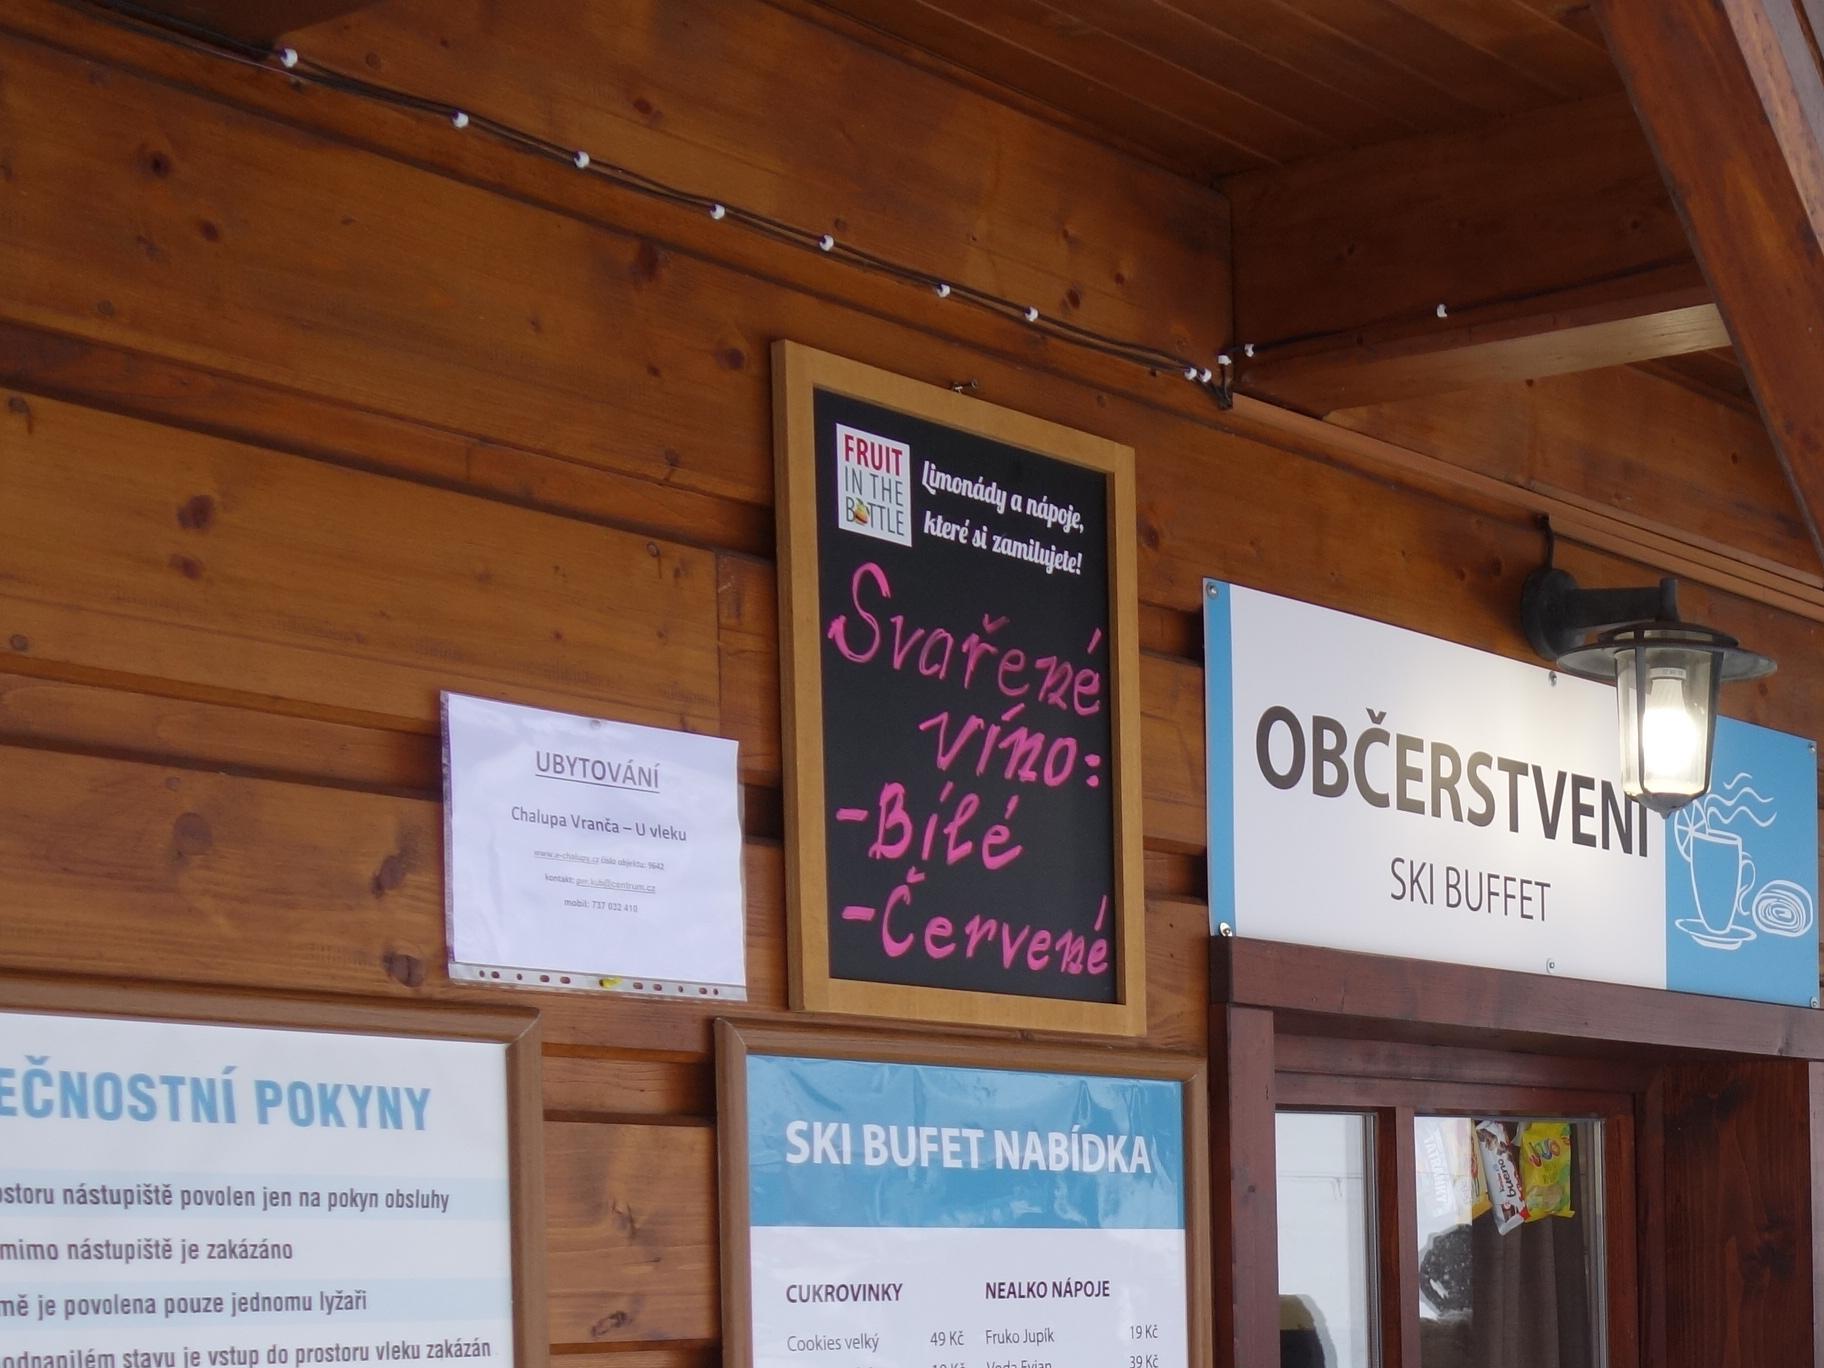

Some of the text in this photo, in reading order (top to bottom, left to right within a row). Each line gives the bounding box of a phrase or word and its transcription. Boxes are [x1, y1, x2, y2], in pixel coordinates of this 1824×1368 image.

[844, 434, 903, 476] FRUIT
[845, 466, 904, 507] IN THE
[922, 461, 1084, 534] Limonády a nápoje,
[924, 511, 1082, 575] které si zamilujete!
[827, 562, 1102, 717] Svařené
[919, 702, 1102, 789] víno:
[536, 750, 660, 790] UBYTOVÁNÍ
[511, 806, 567, 828] Chalupa
[571, 814, 620, 834] Vranča
[635, 822, 646, 836] U
[650, 825, 687, 842] vleku
[1390, 856, 1551, 923] SKI BUFFET
[256, 1080, 432, 1131] POKYNY
[785, 1120, 1152, 1174] SKI BUFET NABÍDKA
[63, 1183, 173, 1209] nástupiště
[180, 1186, 255, 1210] povolen
[262, 1187, 291, 1211] jen
[299, 1192, 320, 1207] na
[328, 1188, 378, 1212] pokyn
[385, 1189, 449, 1213] obsluhy
[1497, 1158, 1517, 1198] bueno
[786, 1283, 903, 1303] CUKROVINKY
[986, 1277, 1110, 1299] NEALKO NÁPOJE
[787, 1331, 964, 1353] Cookies velký 49 Kč
